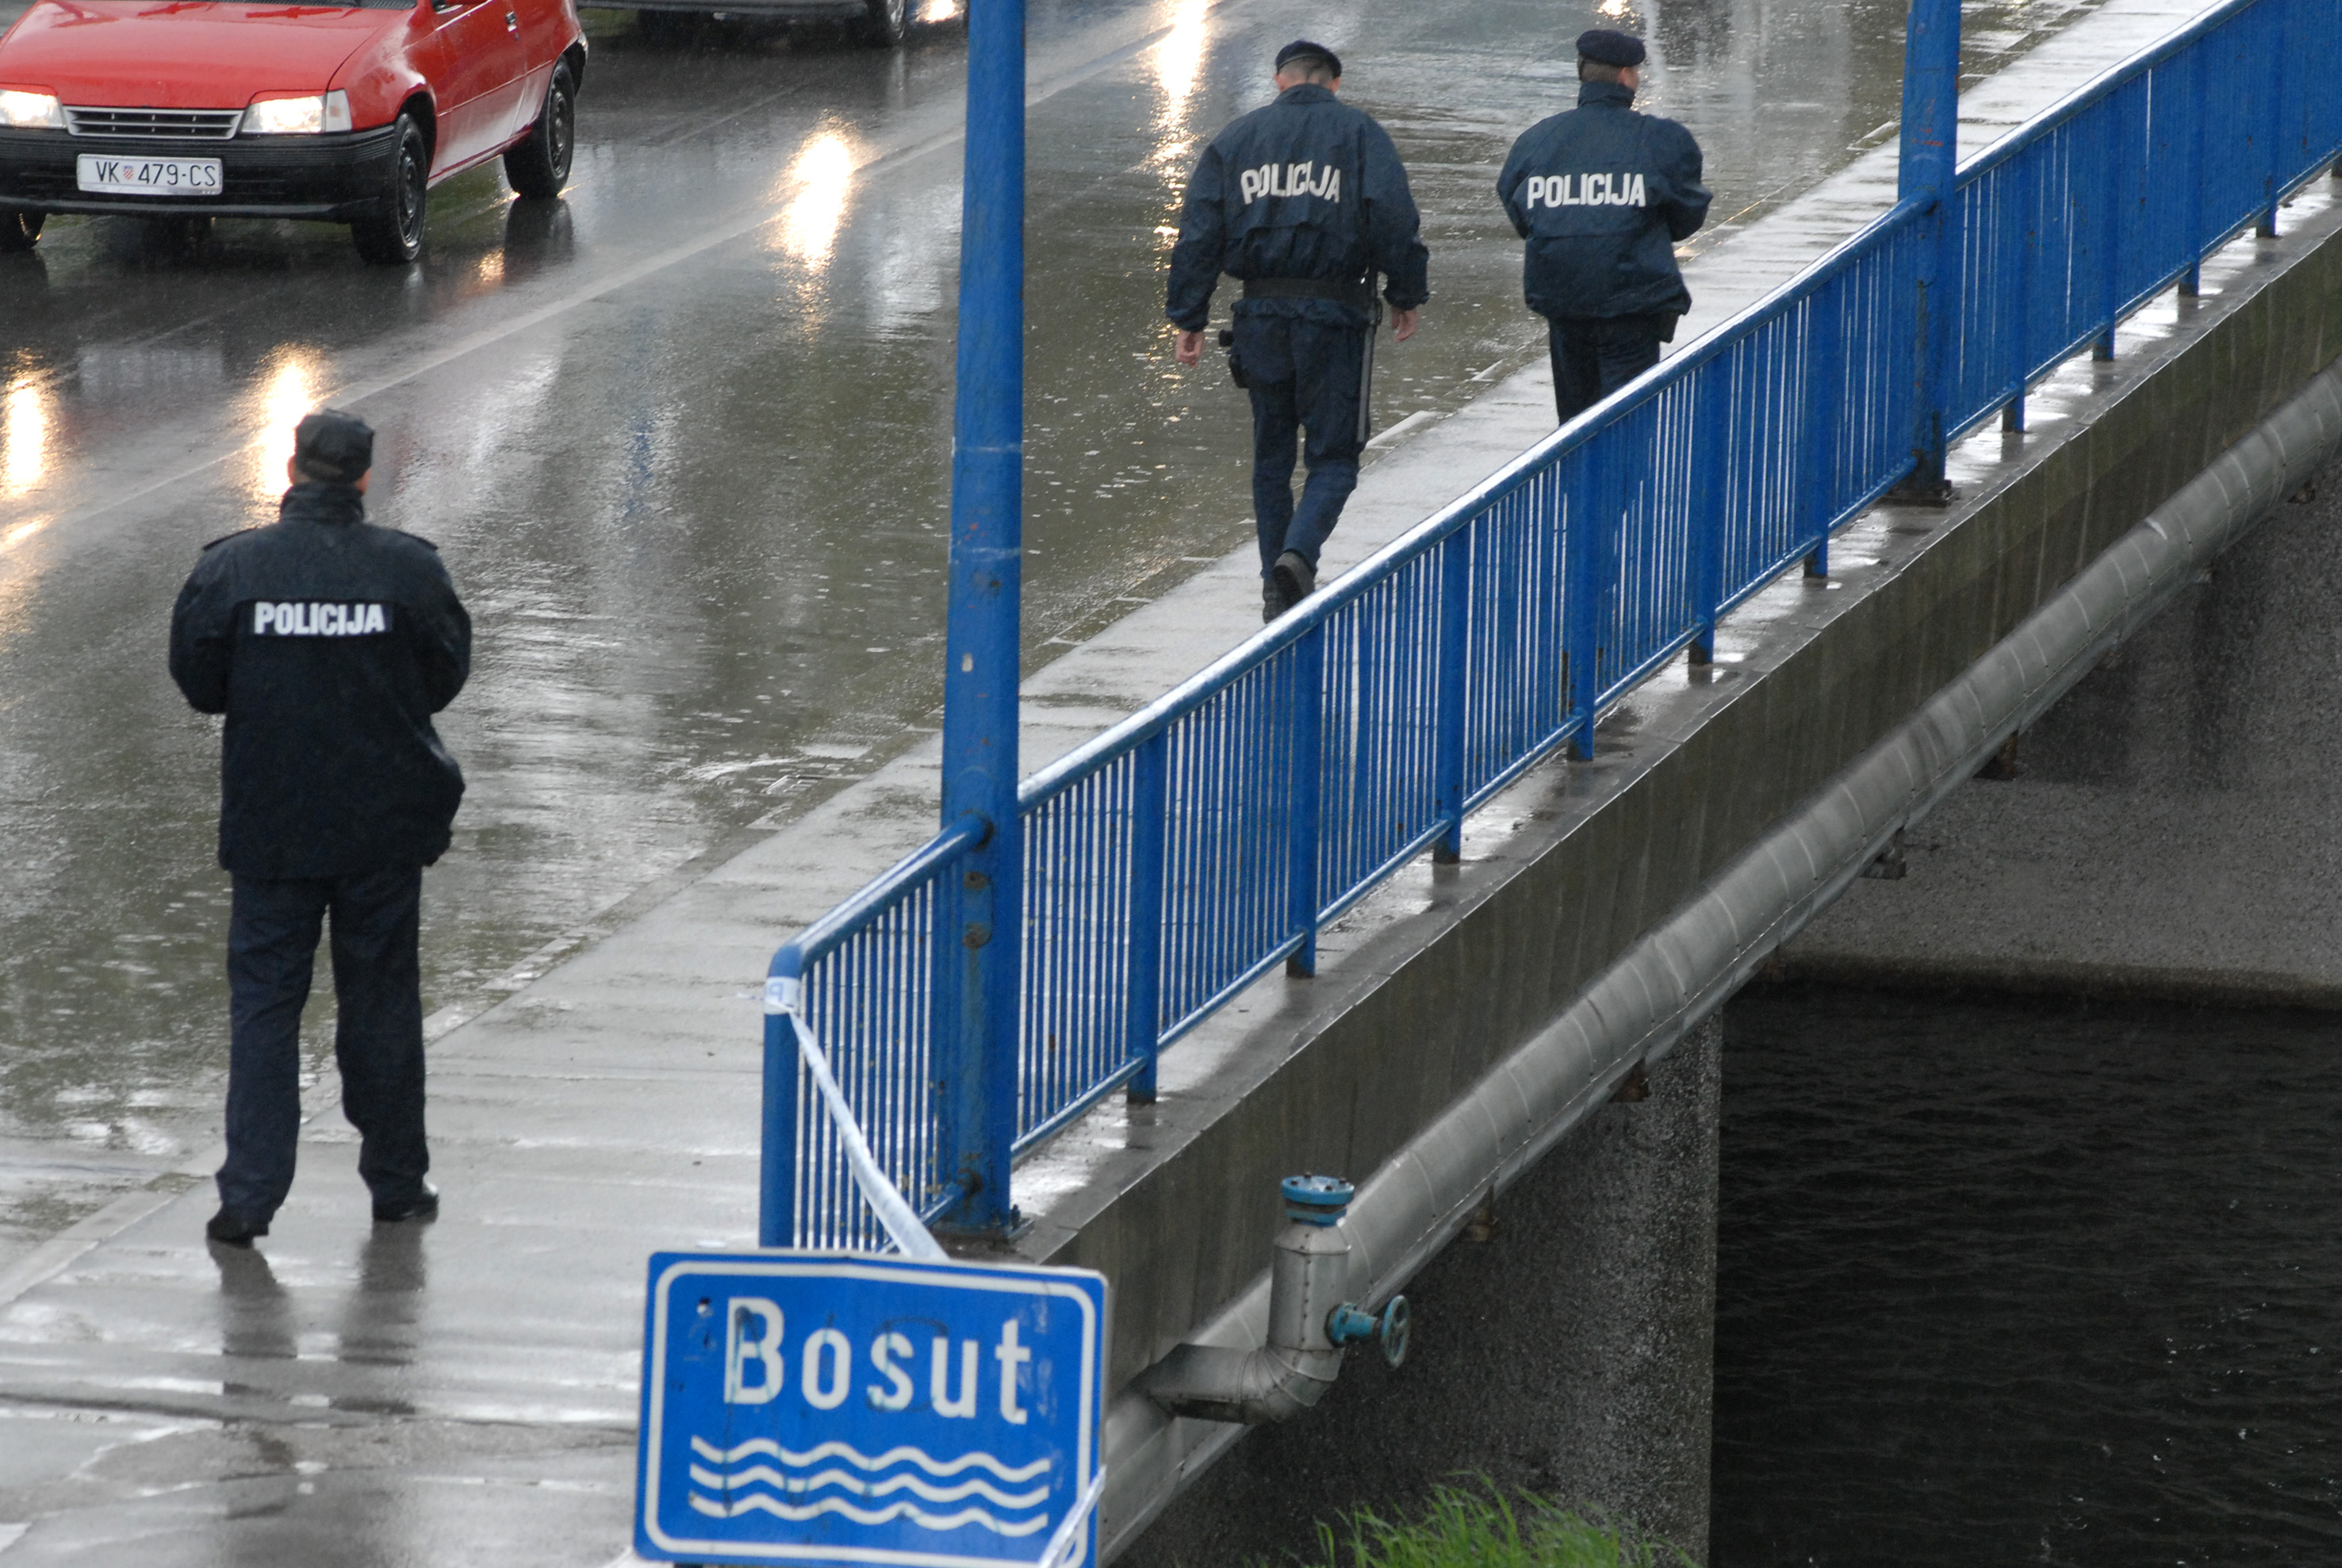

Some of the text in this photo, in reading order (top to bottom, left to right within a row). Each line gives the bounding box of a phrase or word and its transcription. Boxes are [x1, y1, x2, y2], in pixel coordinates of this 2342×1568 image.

[95, 160, 217, 187] VK 479-CS
[1240, 159, 1341, 205] POLICIJA
[1527, 172, 1646, 210] POLICIJA
[254, 600, 386, 636] POLICIJA
[723, 1296, 1031, 1424] Bosut
